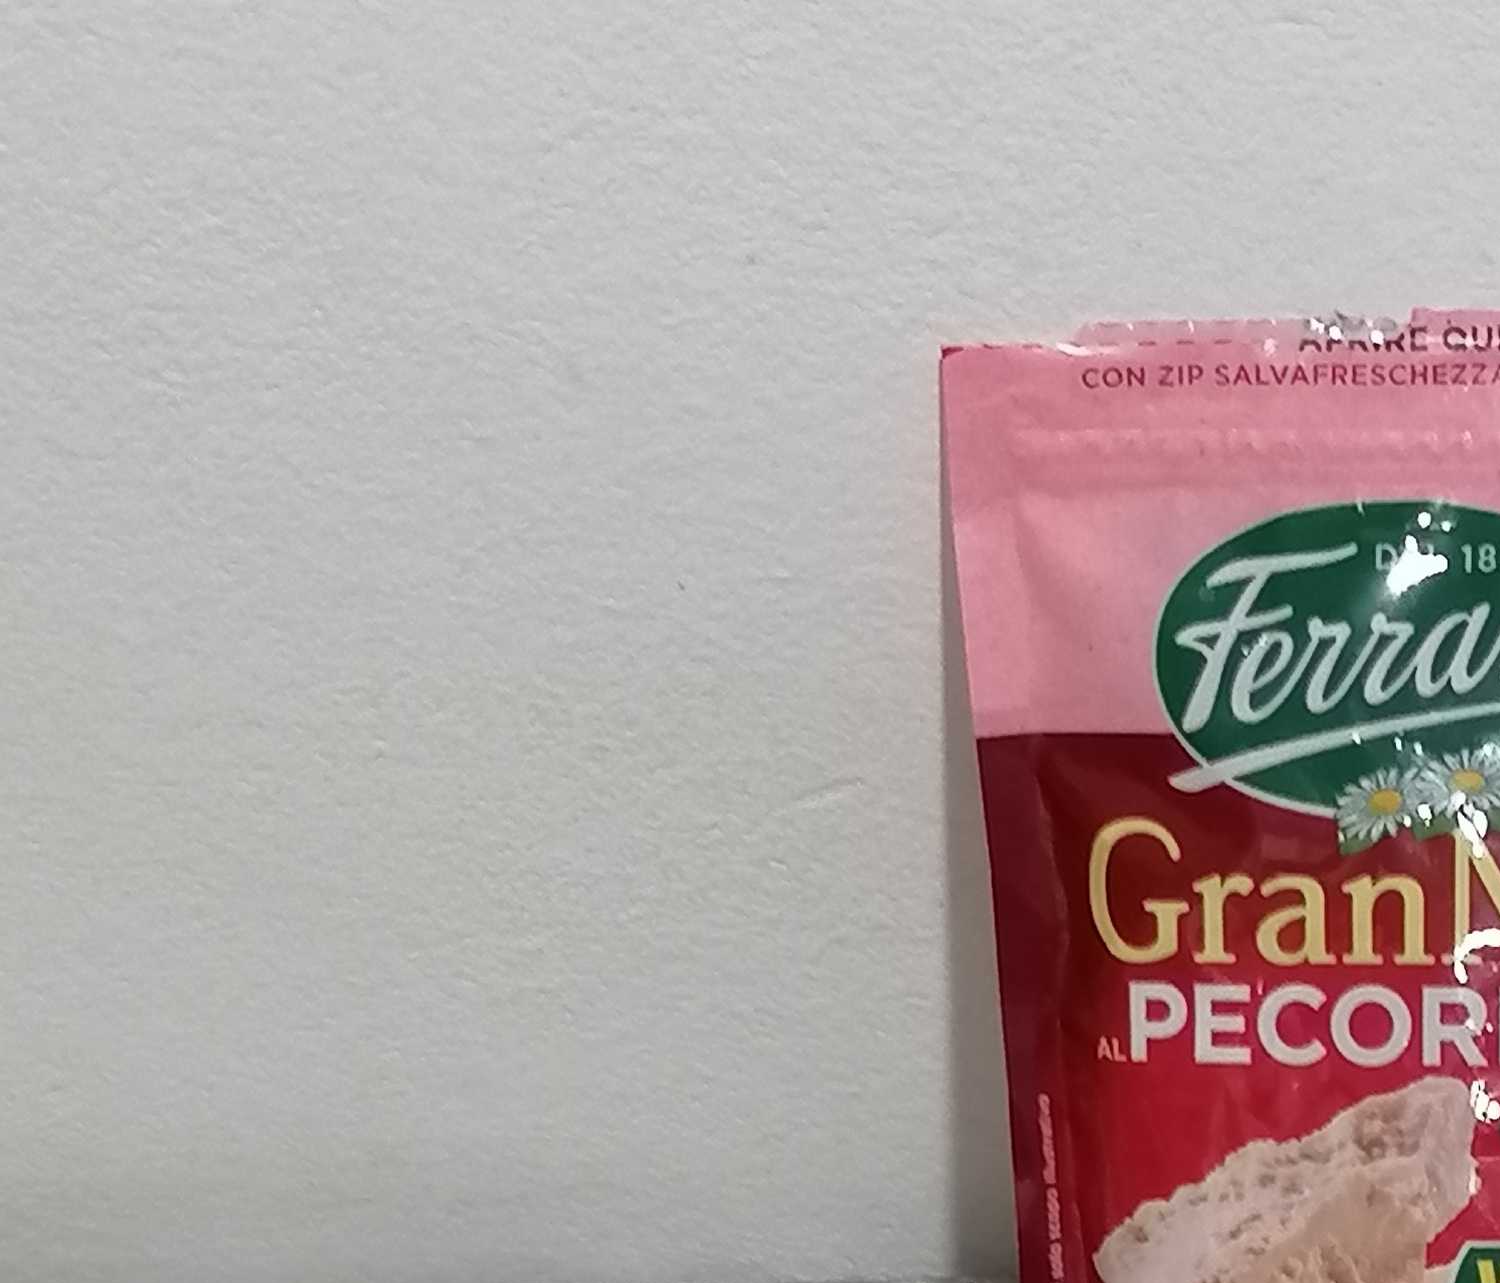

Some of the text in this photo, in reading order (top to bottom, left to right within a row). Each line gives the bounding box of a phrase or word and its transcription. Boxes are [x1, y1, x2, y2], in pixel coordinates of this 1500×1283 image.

[1081, 366, 1146, 389] CON
[1158, 364, 1204, 387] ZIP
[1097, 1035, 1127, 1061] AL
